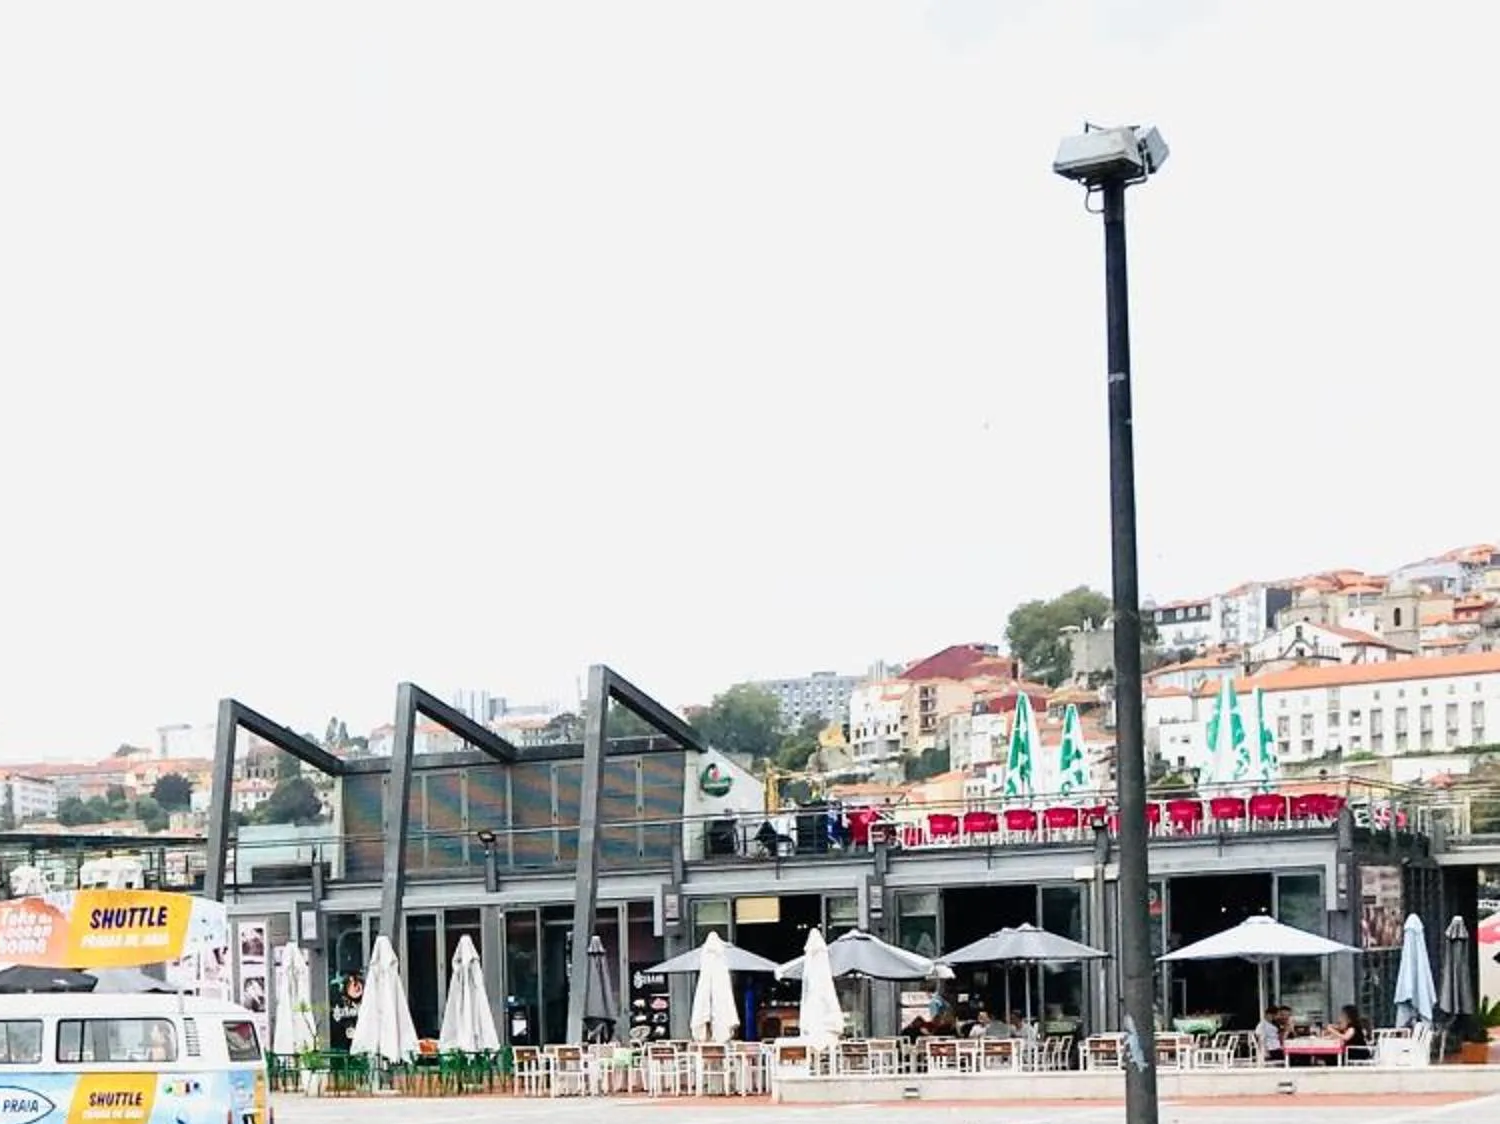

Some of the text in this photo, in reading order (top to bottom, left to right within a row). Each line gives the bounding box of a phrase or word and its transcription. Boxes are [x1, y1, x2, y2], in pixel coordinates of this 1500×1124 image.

[89, 906, 168, 929] SHUTTLE
[3, 1099, 39, 1113] PRAIA
[88, 1091, 144, 1107] SHUTTLE
